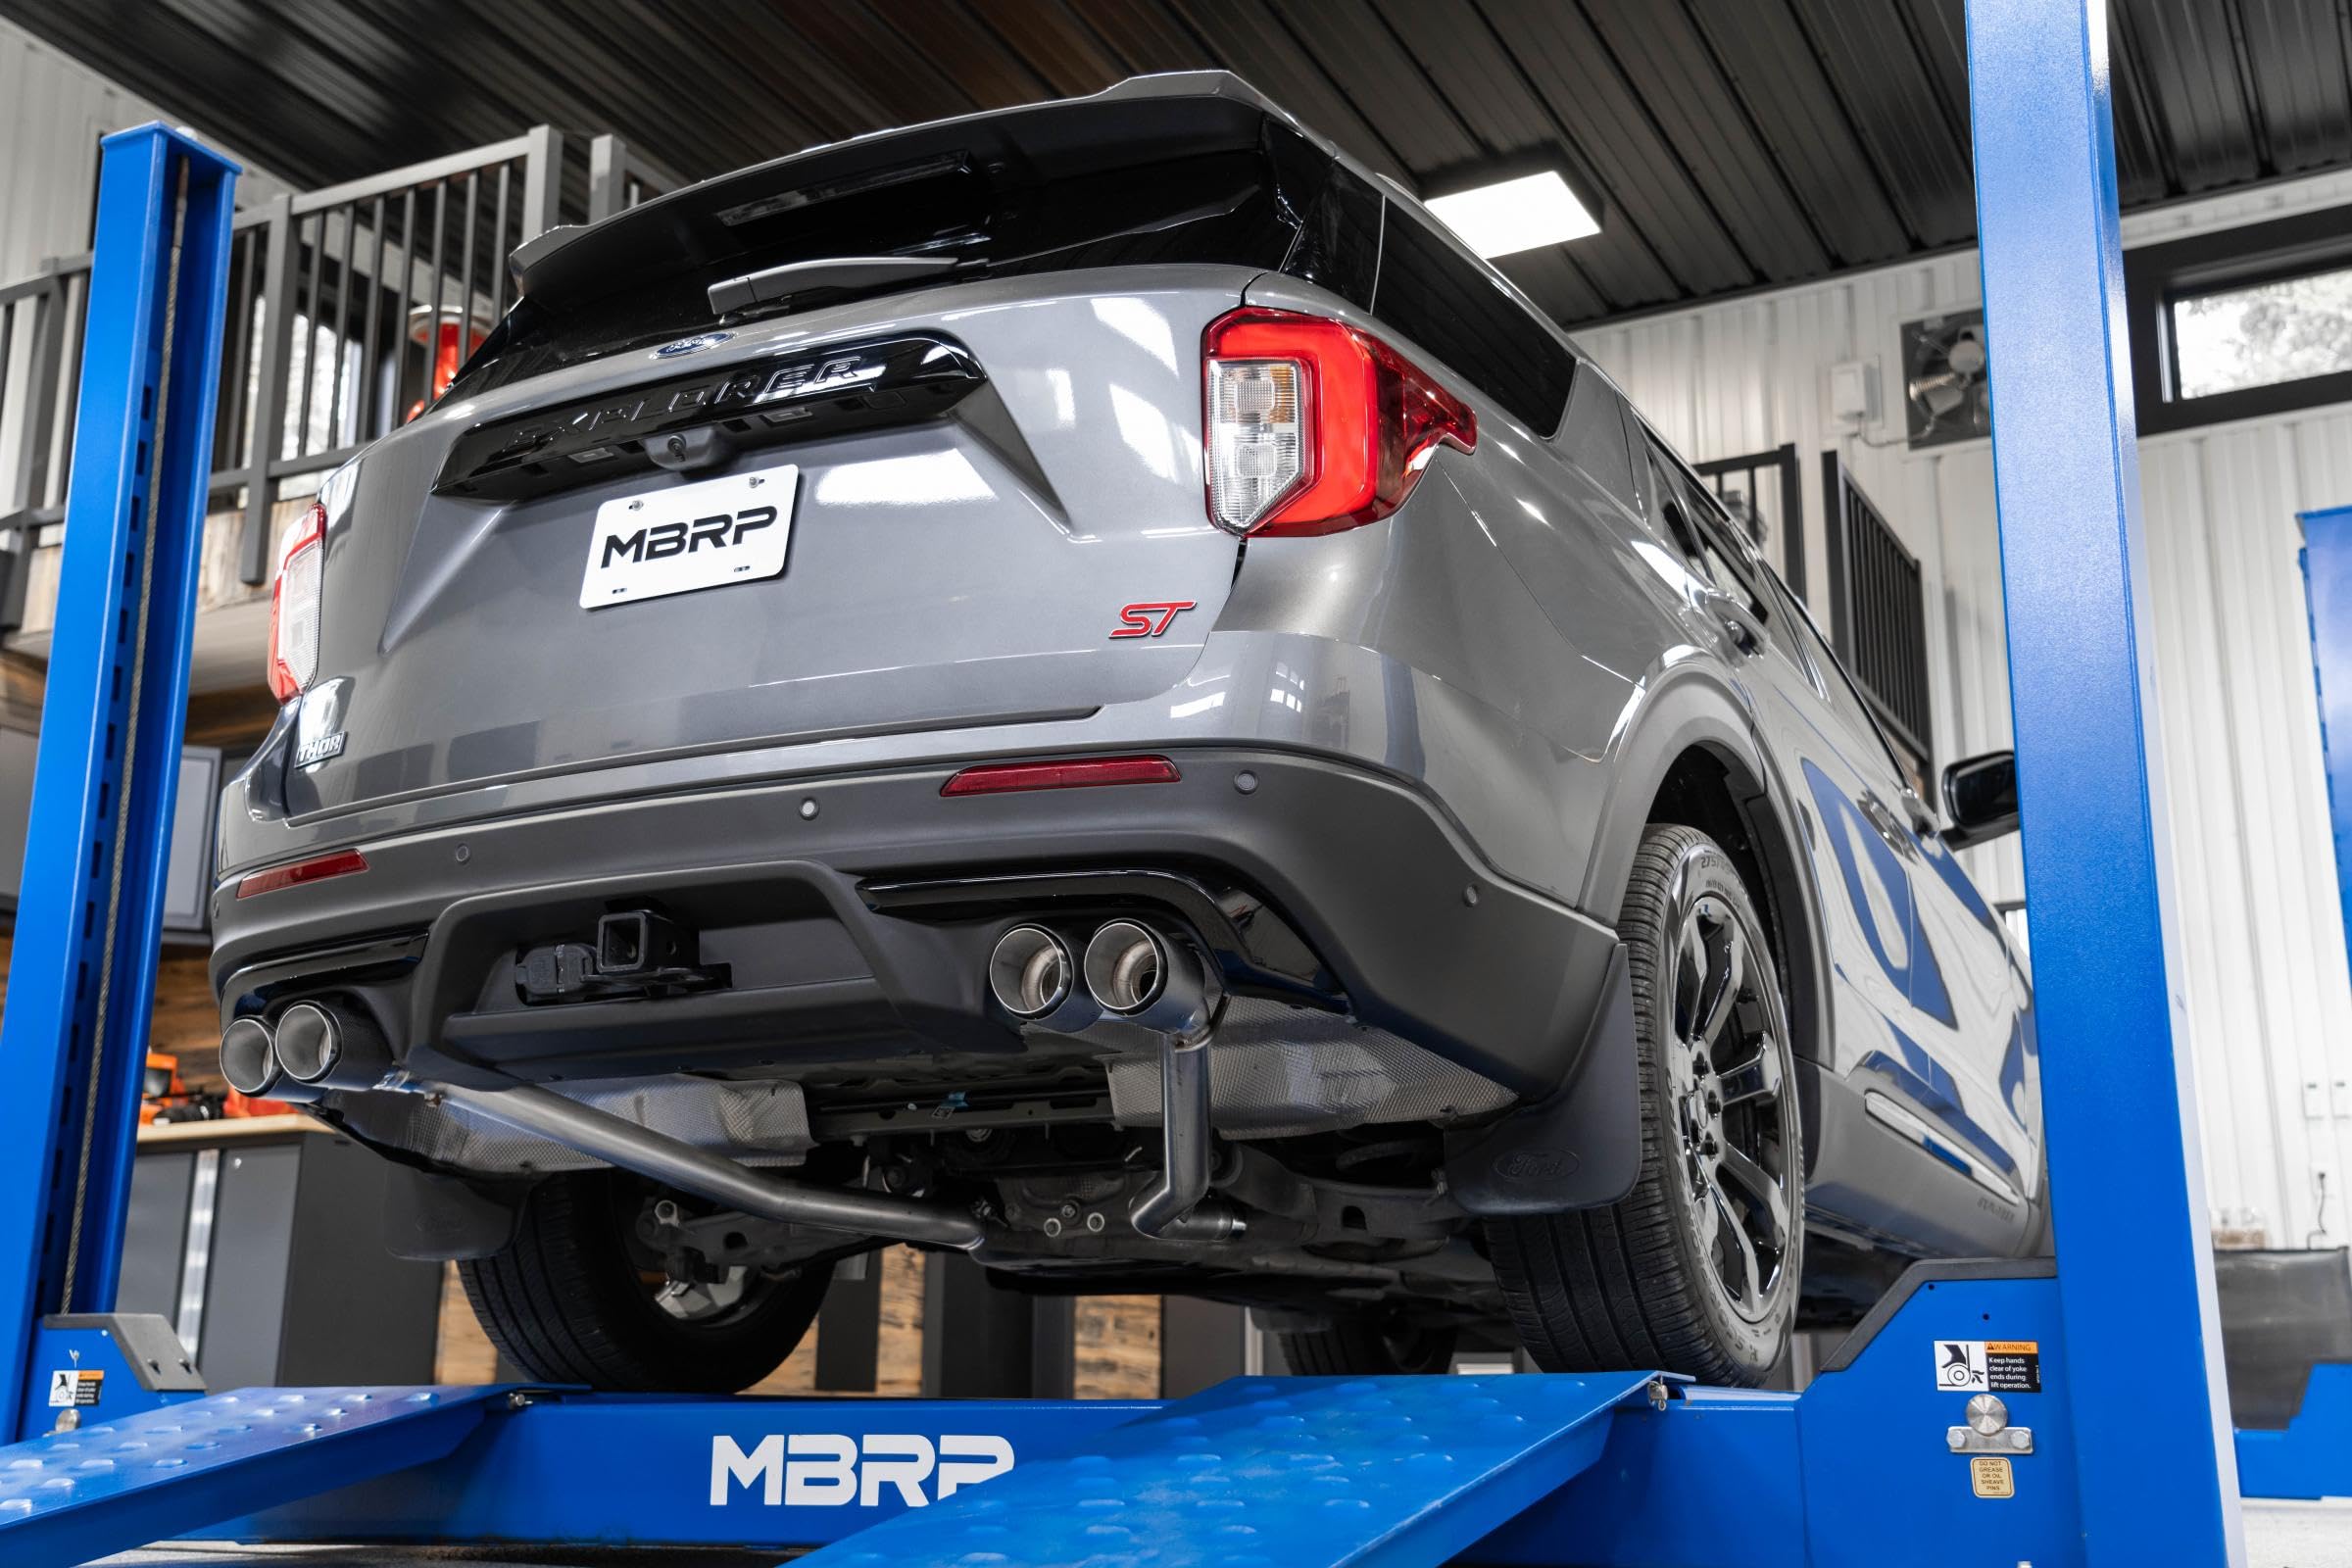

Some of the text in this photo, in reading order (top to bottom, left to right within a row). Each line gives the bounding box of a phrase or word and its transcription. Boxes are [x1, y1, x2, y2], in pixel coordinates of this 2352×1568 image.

[600, 505, 778, 569] MBRP
[1108, 600, 1198, 639] ST
[298, 734, 342, 762] THOR
[1993, 1344, 2032, 1352] WARNING
[710, 1434, 1015, 1507] MBRP
